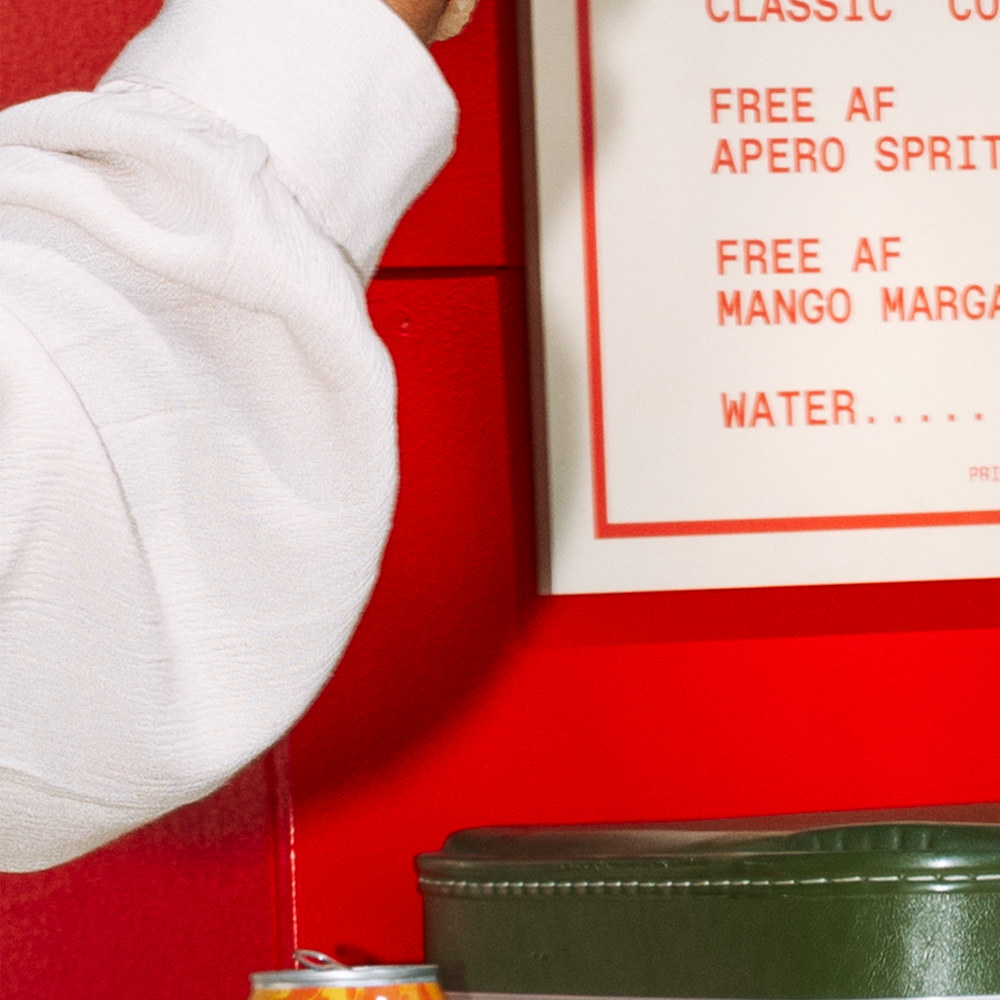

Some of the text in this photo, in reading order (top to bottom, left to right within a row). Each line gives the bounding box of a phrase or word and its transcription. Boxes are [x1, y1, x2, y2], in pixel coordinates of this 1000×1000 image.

[710, 86, 896, 124] FREE AF
[711, 136, 847, 174] APERO
[716, 236, 902, 275] FREE AF
[716, 287, 853, 326] MANGO
[720, 389, 857, 428] WATER
